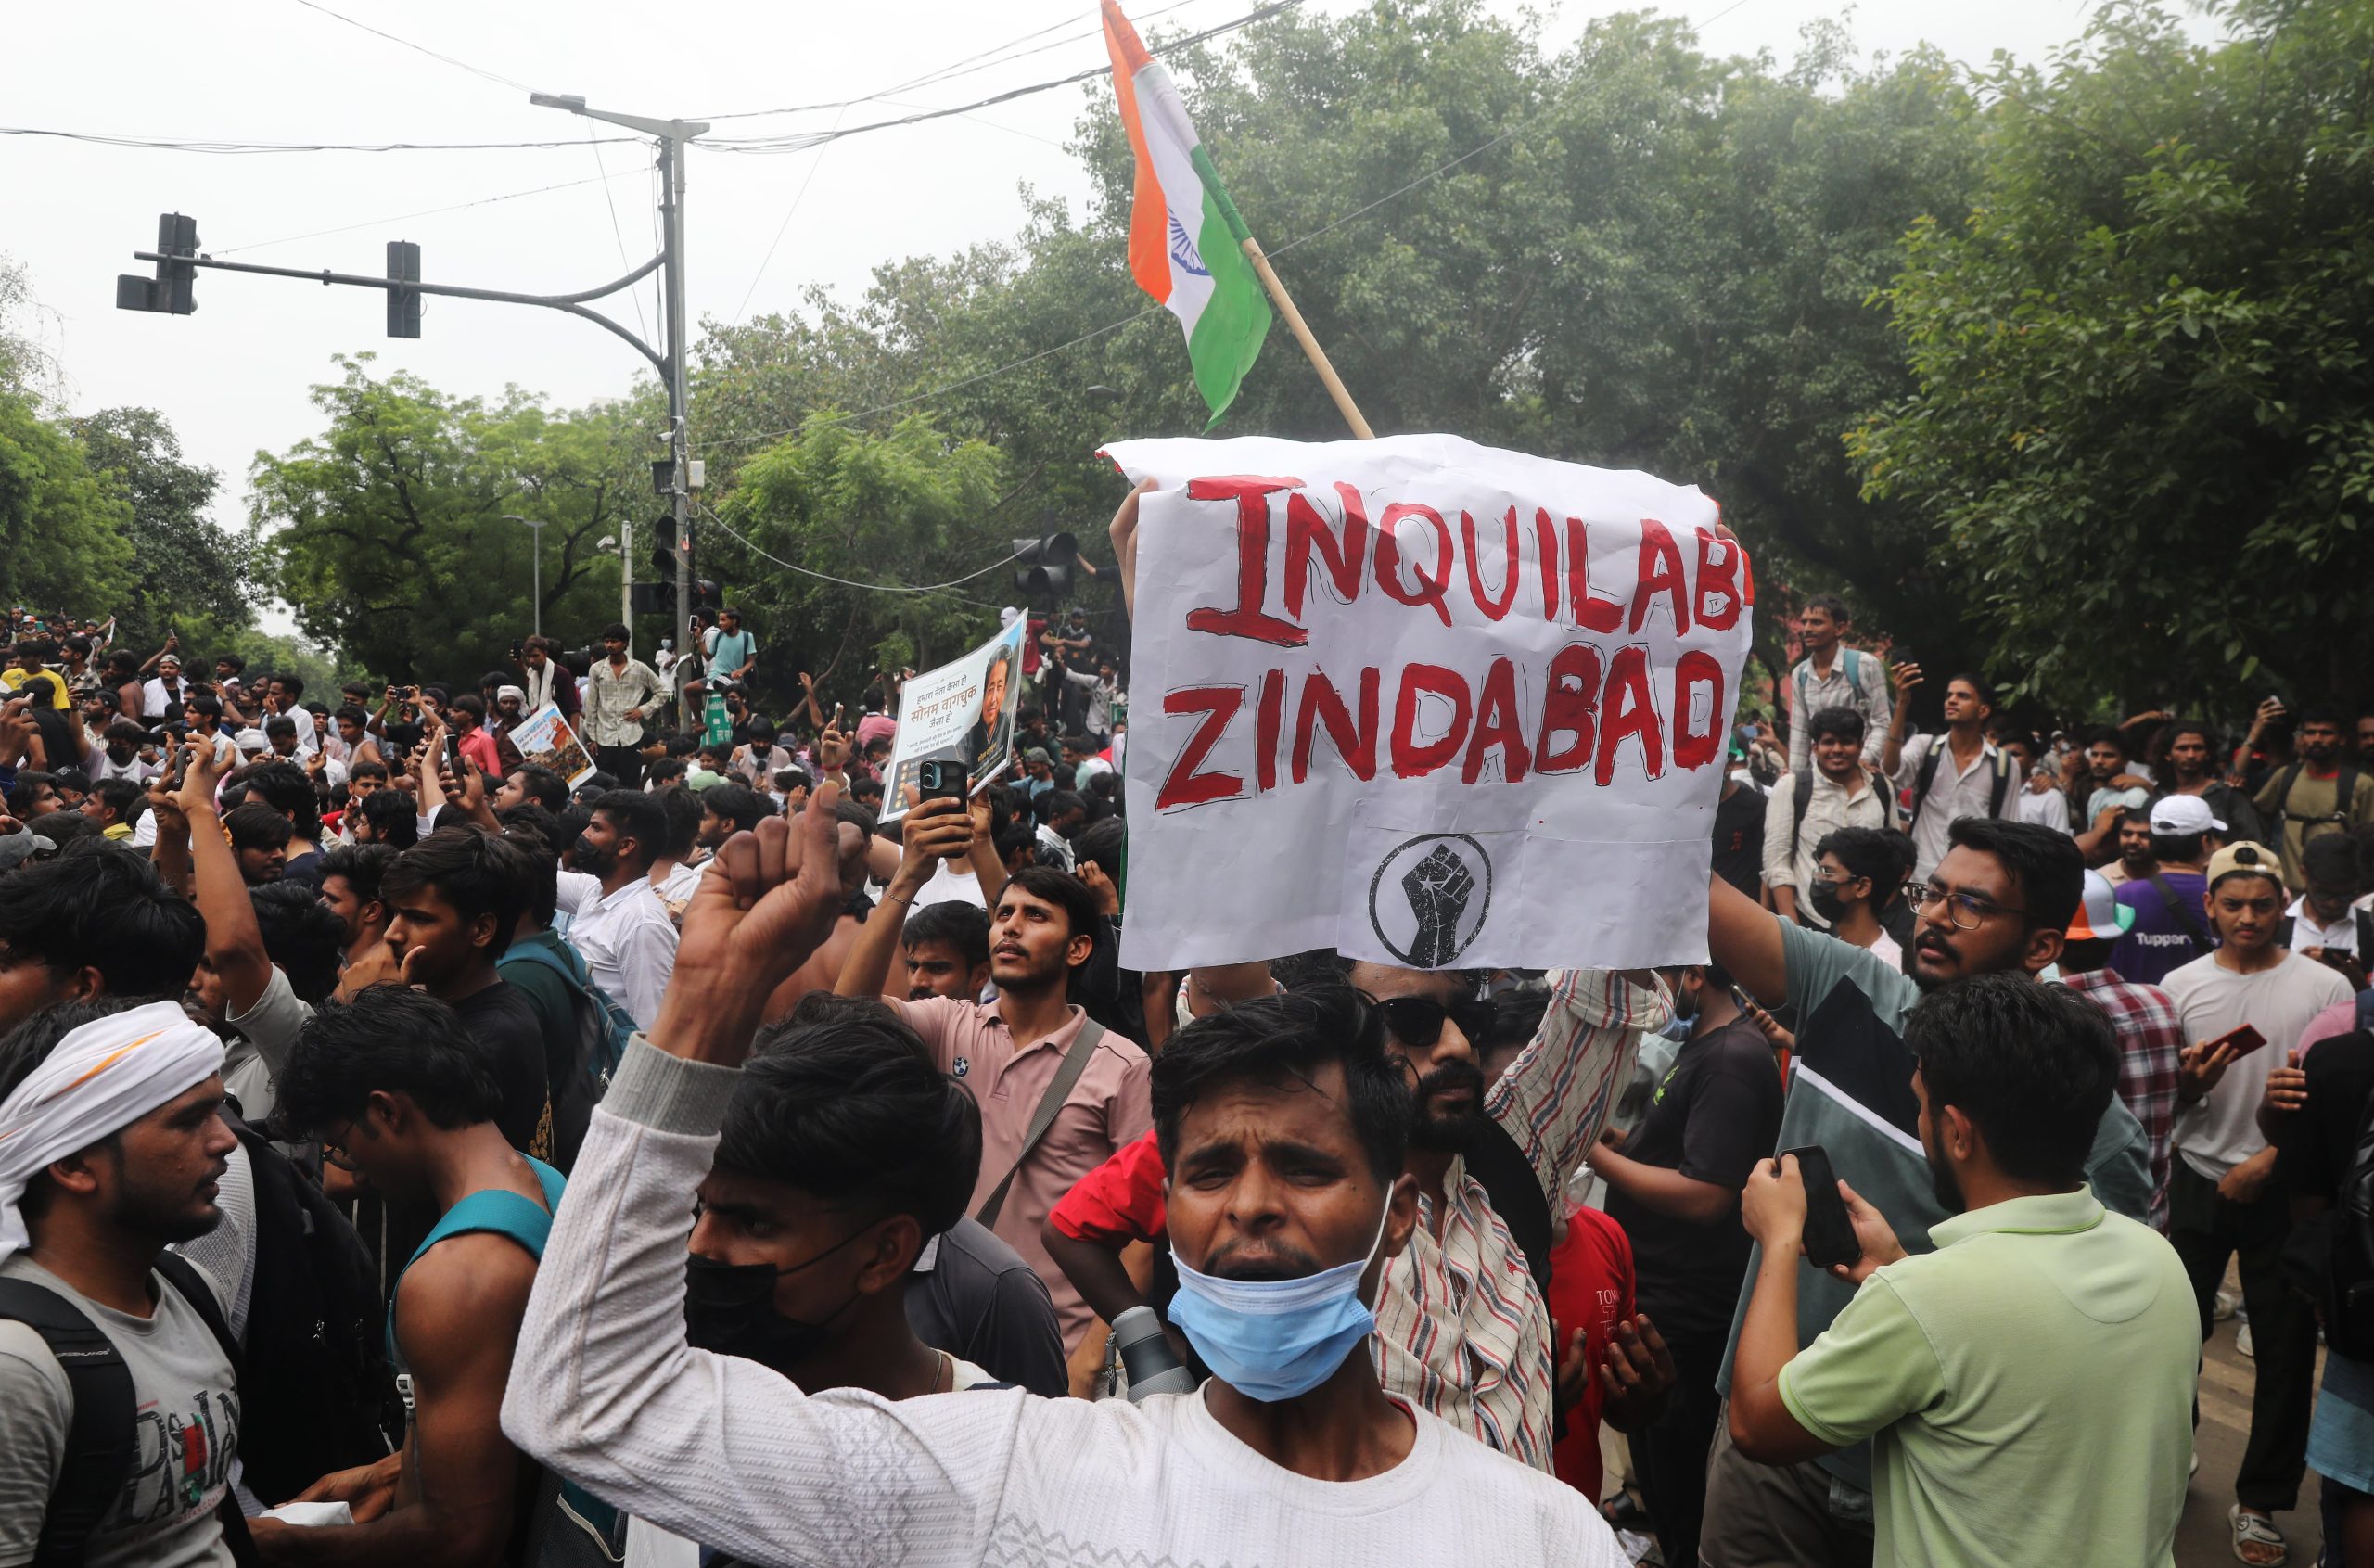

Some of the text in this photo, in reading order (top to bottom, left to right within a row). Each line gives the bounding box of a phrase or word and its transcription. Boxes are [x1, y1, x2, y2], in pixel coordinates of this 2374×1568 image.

[1186, 474, 1742, 647] INQUILAB
[910, 684, 977, 723] सोनम वांगचुक
[916, 691, 934, 705] हमारा
[961, 674, 968, 686] हो
[929, 710, 953, 728] जैसा हो
[1155, 642, 1727, 814] ZINDABAD
[2135, 932, 2221, 948] Tupper
